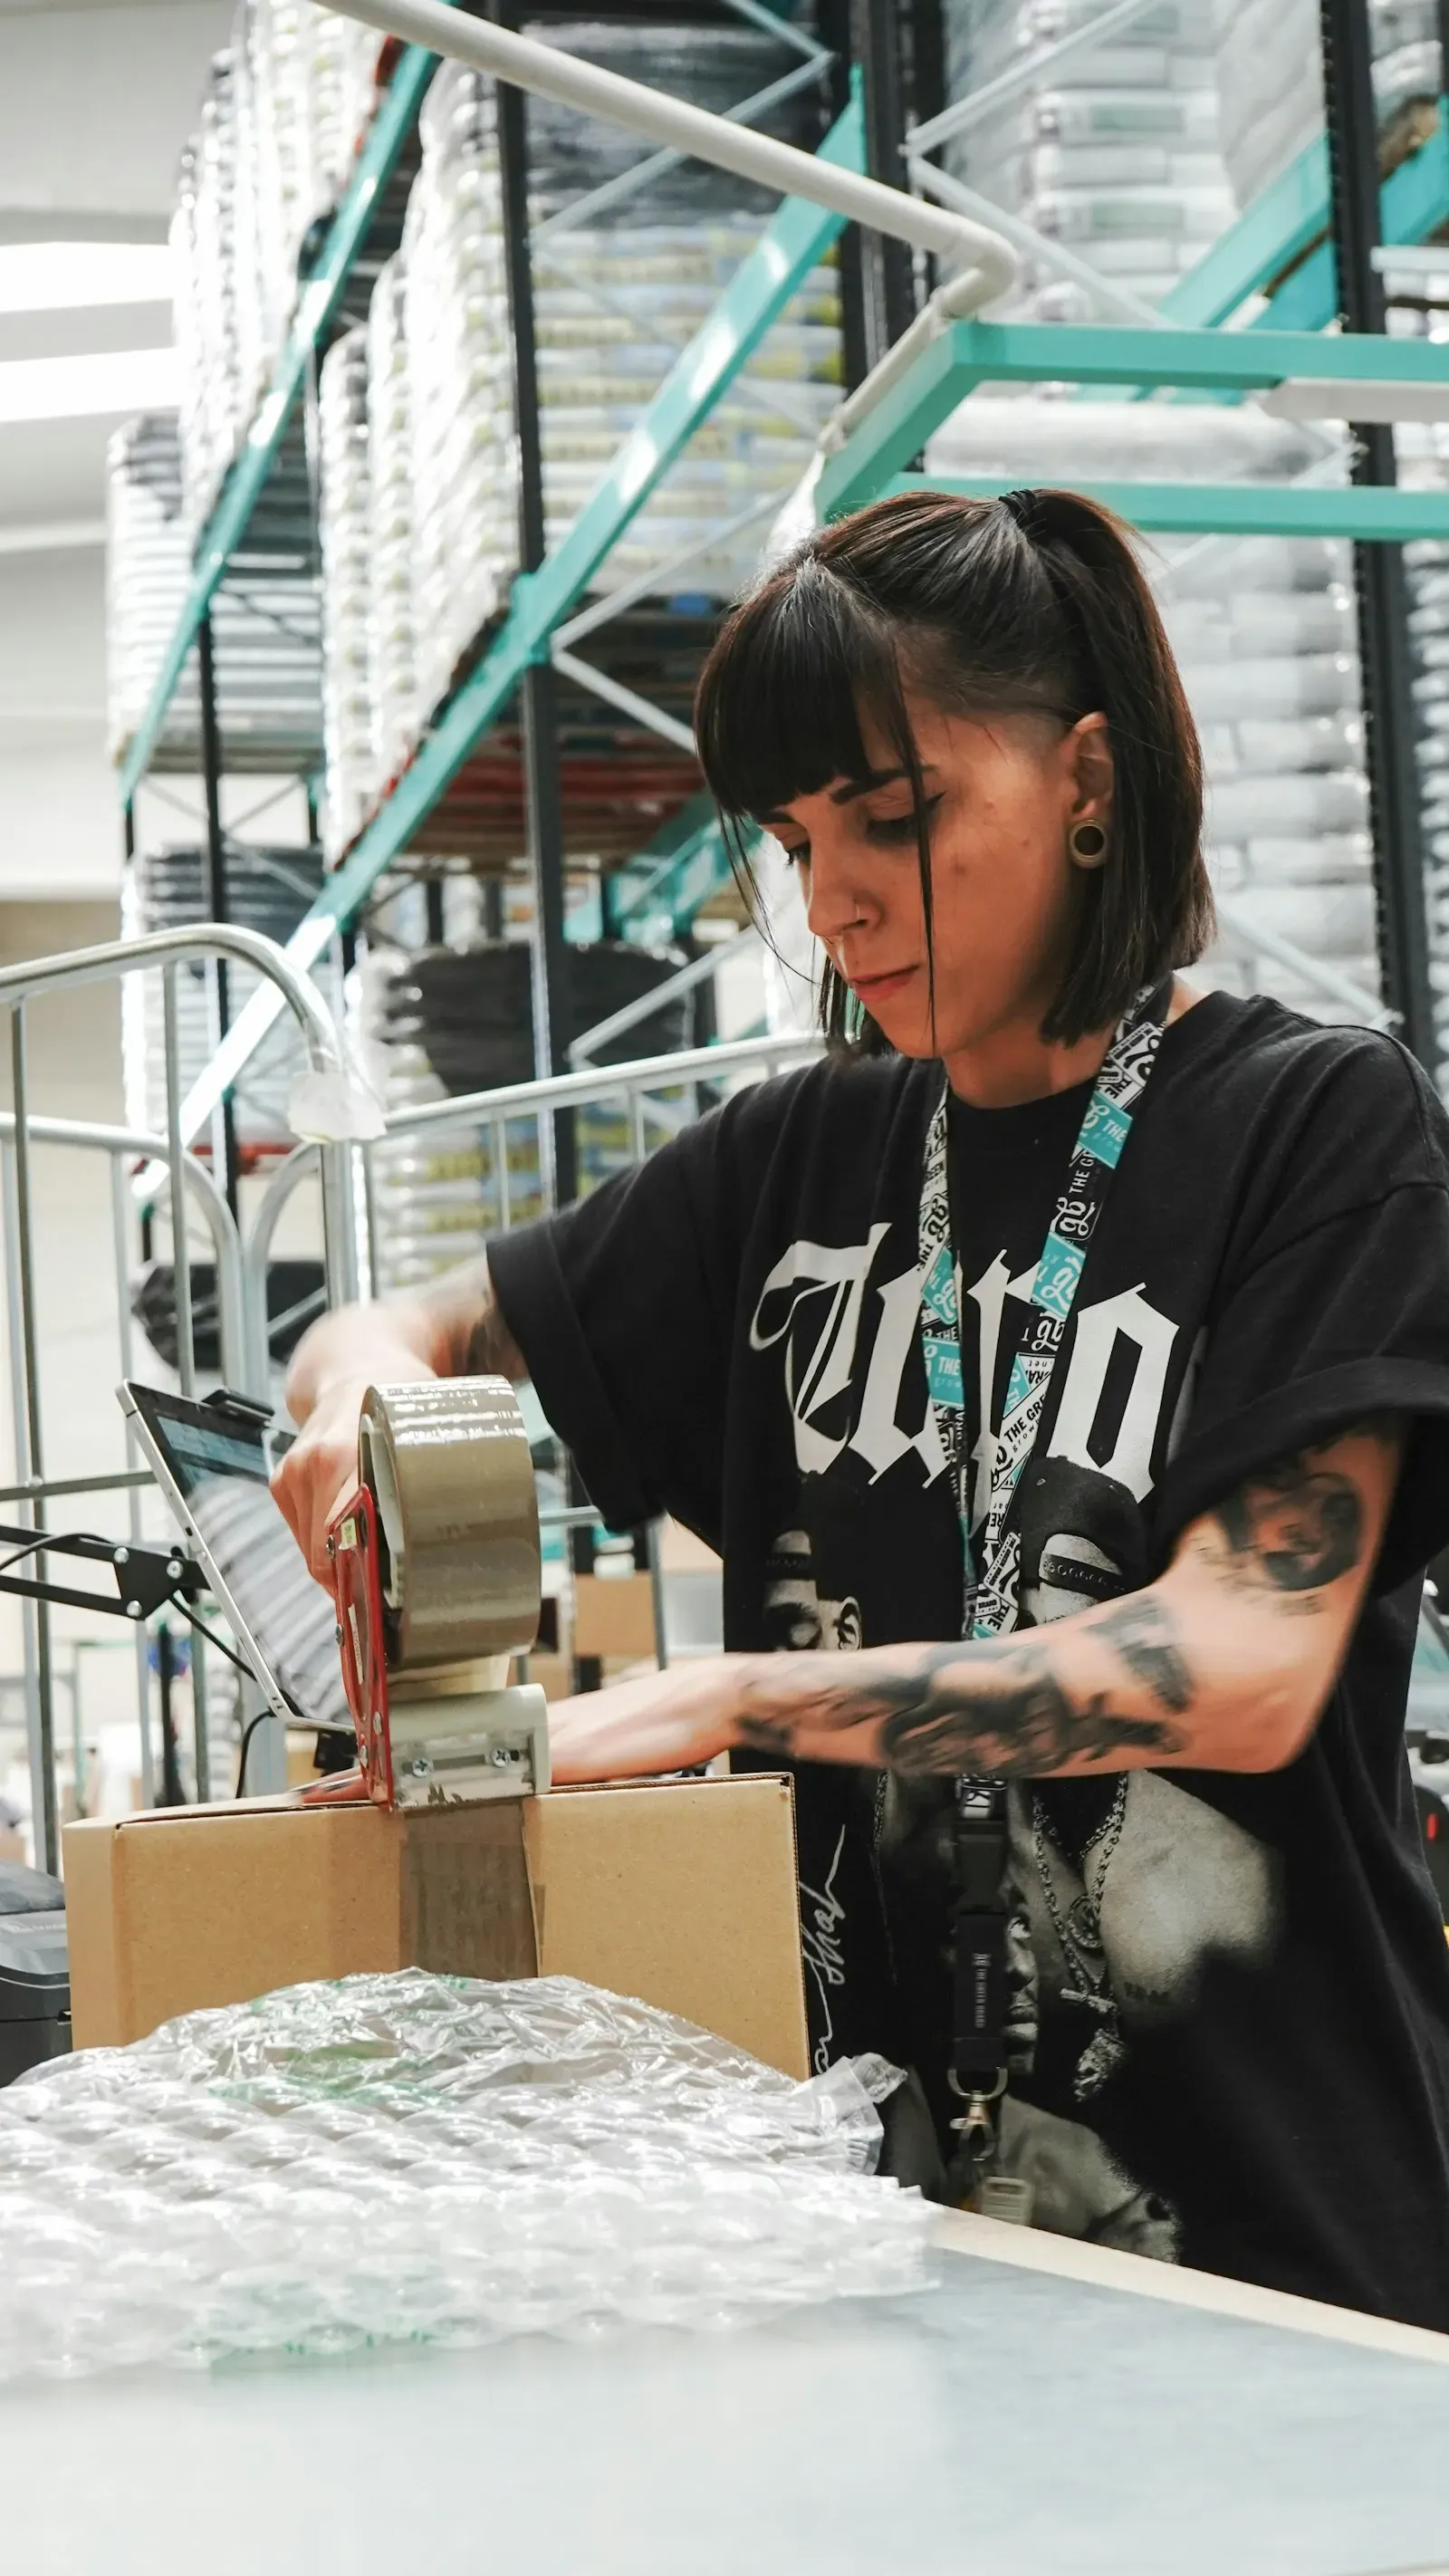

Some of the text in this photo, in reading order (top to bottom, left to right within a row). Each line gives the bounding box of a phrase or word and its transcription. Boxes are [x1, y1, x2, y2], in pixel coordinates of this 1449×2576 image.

[1069, 1169, 1090, 1194] THE
[937, 1356, 962, 1376] THE
[1004, 1417, 1027, 1442] THE
[988, 1605, 1011, 1630] THE
